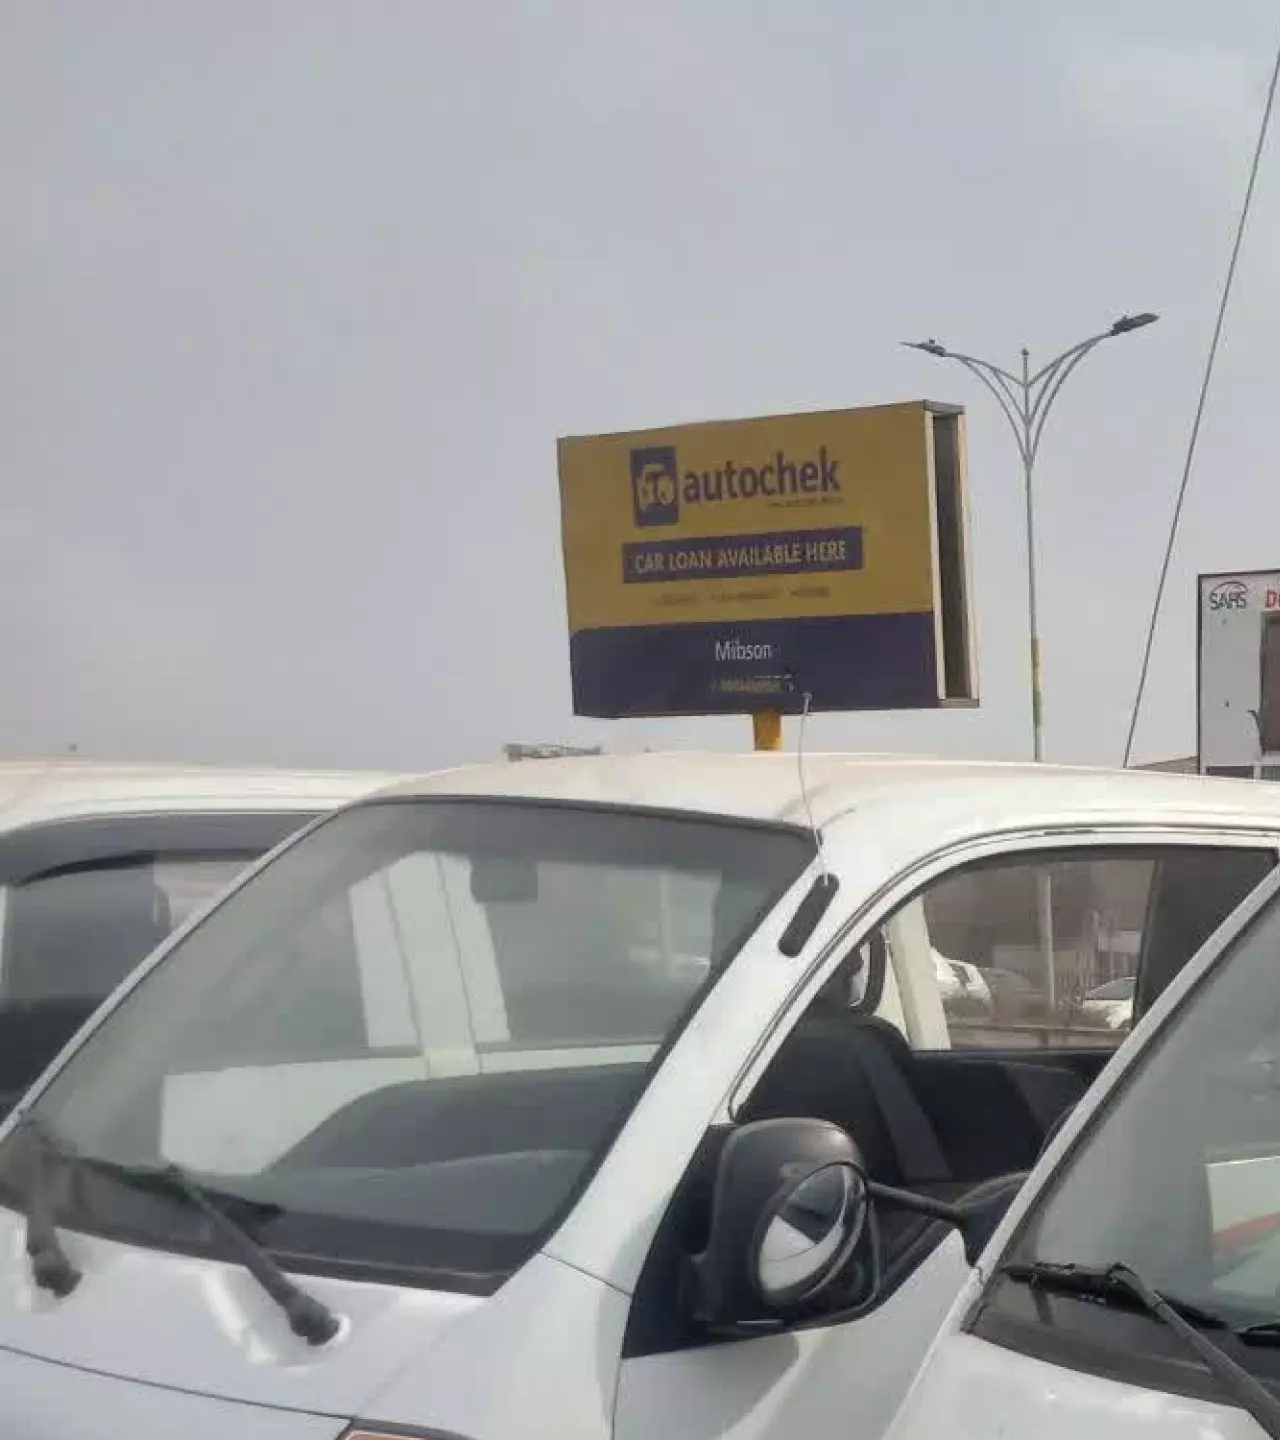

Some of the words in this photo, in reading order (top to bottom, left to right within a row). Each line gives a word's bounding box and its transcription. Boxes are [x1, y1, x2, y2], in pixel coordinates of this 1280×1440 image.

[684, 446, 840, 504] autochek
[635, 552, 664, 574] CAR
[669, 550, 712, 571] LOAN
[713, 543, 801, 568] AVAILABLE
[806, 539, 847, 562] HERE
